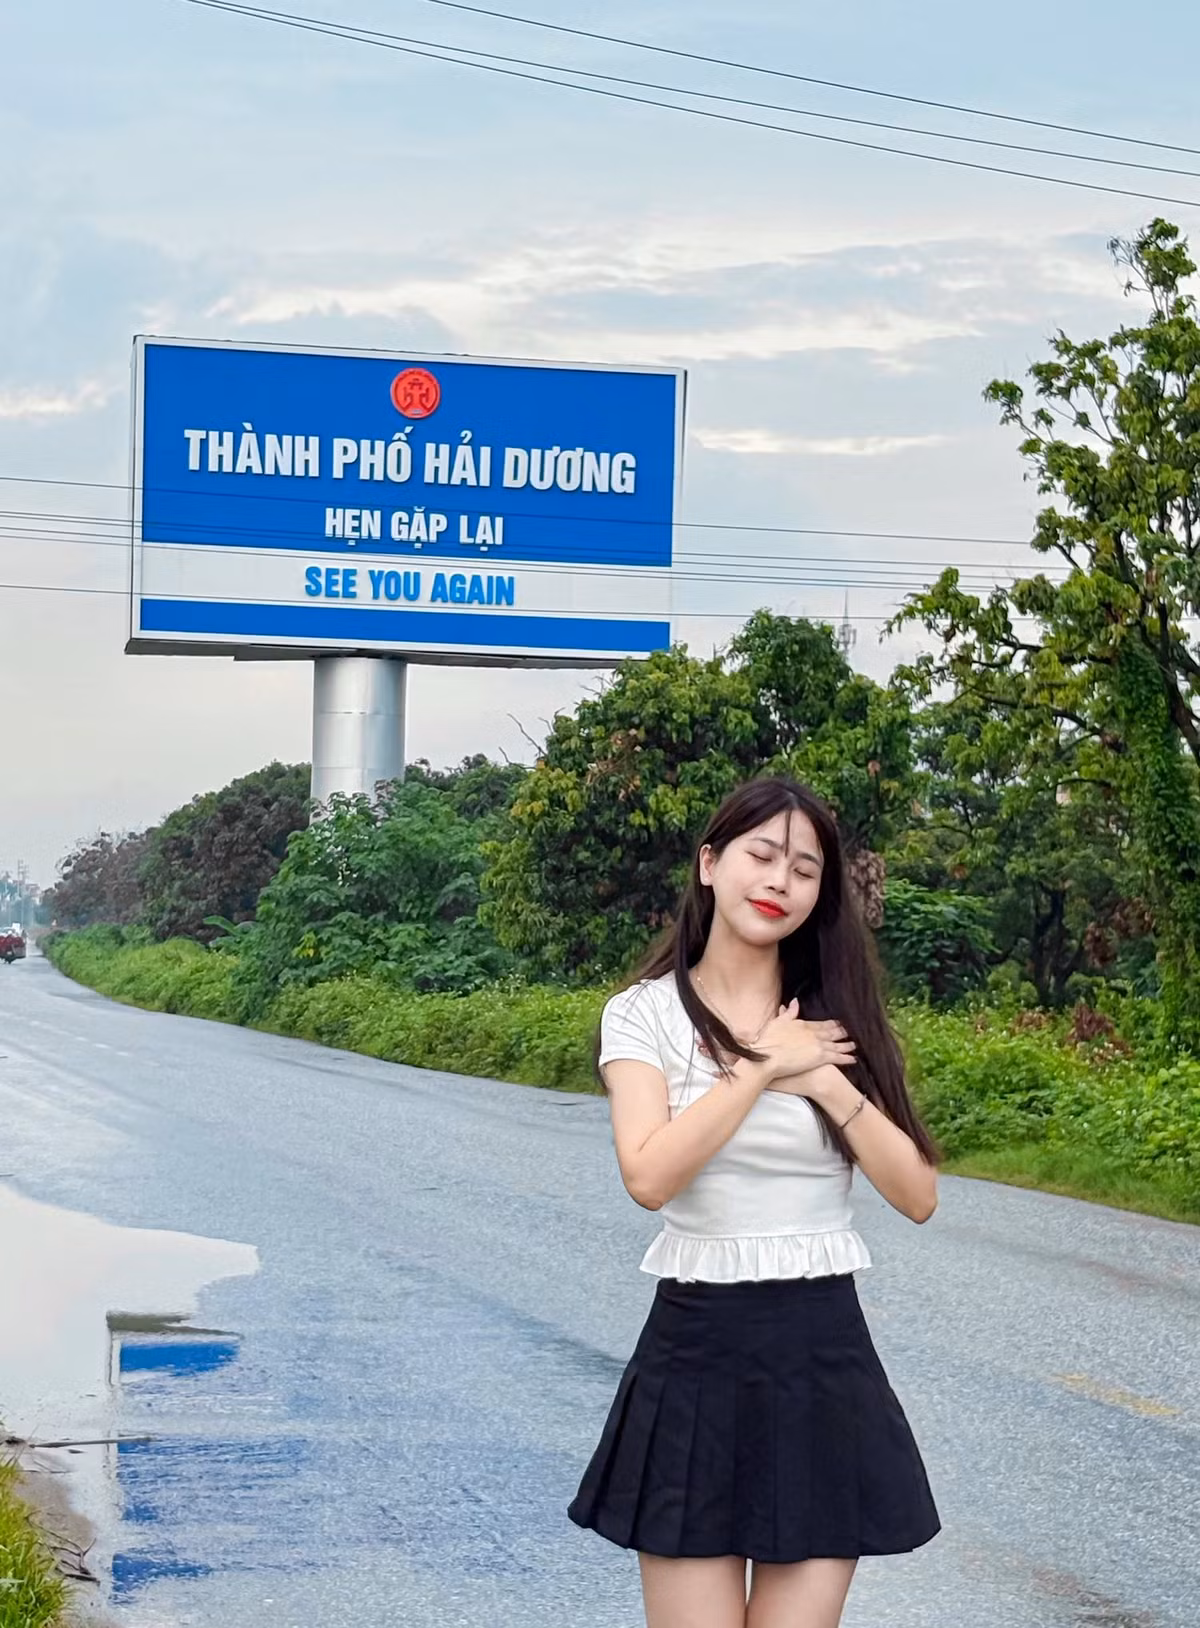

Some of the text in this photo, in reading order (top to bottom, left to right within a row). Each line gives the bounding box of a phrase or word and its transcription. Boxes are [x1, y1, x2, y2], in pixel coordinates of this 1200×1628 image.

[184, 422, 635, 494] THÀNH PHỐ HẢI DƯƠNG
[325, 505, 504, 551] HẸN GẶP LẠI
[305, 566, 515, 605] SEE YOU AGAIN
